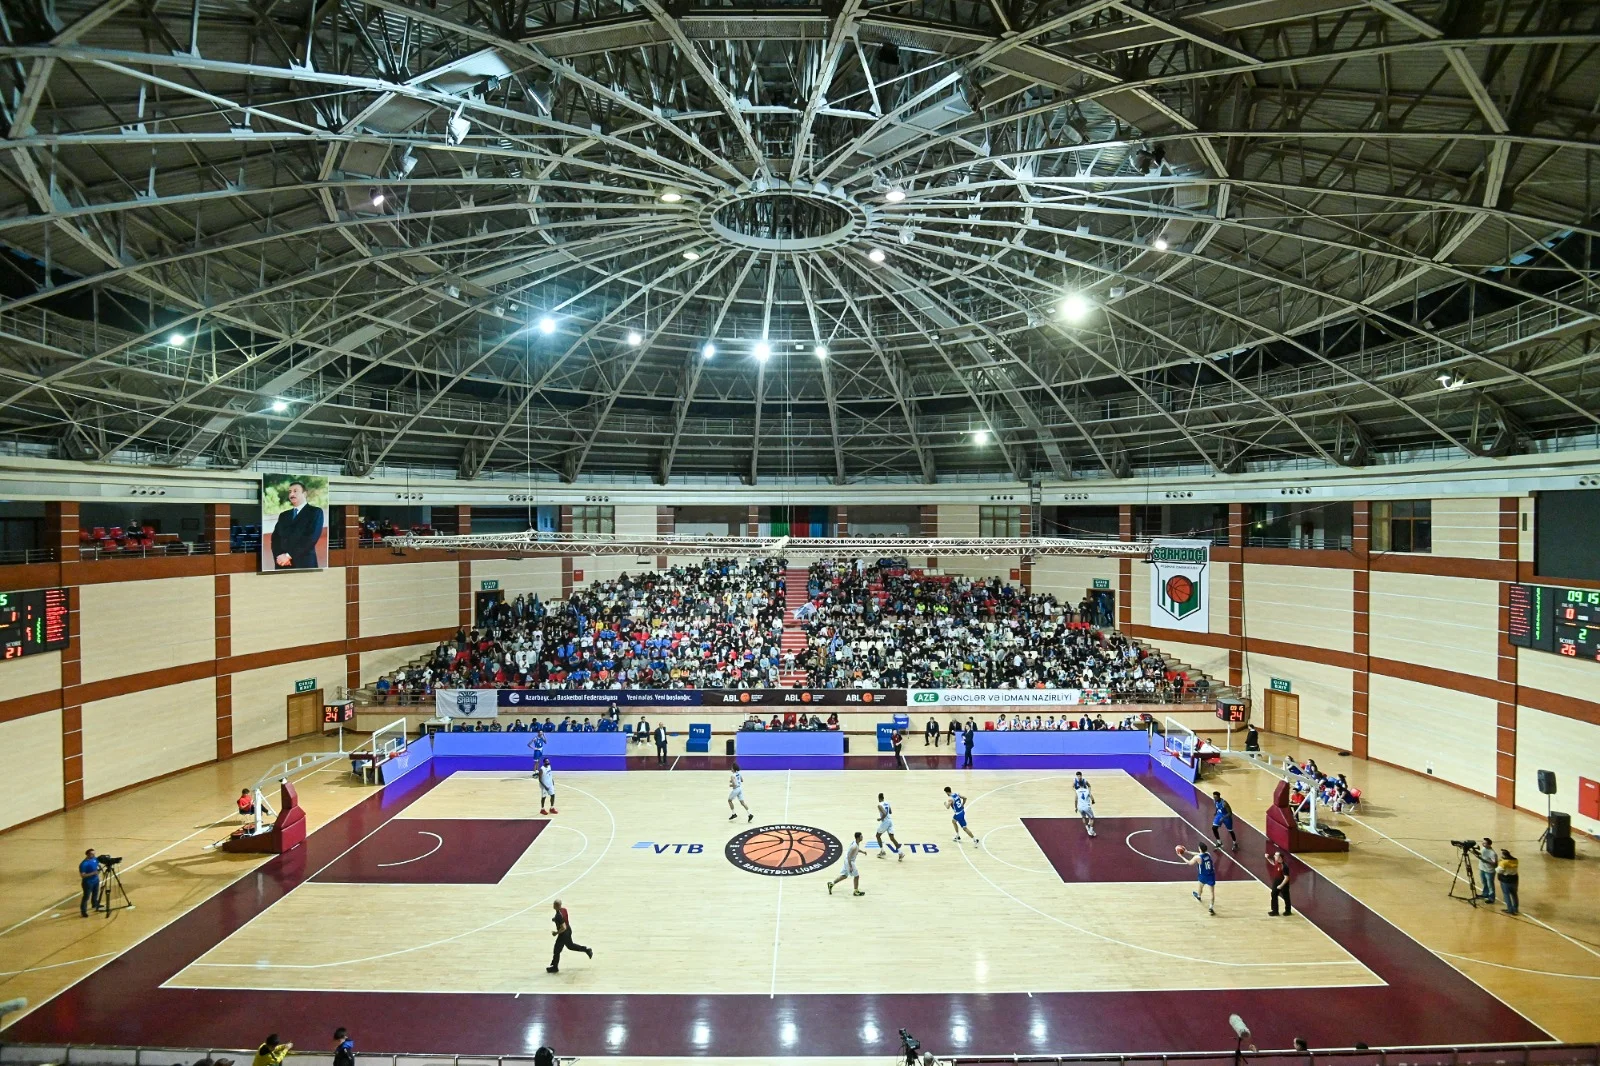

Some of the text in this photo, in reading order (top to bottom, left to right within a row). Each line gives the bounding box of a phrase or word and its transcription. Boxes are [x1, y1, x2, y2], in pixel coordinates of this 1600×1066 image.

[1152, 546, 1207, 564] SƏRHƏDÇİ
[1568, 590, 1599, 604] 09 15
[1561, 644, 1576, 656] 26
[1001, 693, 1029, 701] İDMAN
[1032, 693, 1072, 701] NAZİRLİYİ
[326, 713, 337, 722] 24
[1230, 712, 1242, 721] 24
[654, 844, 704, 854] VTB
[886, 844, 940, 854] VTB
[742, 863, 794, 874] BASKETBOL
